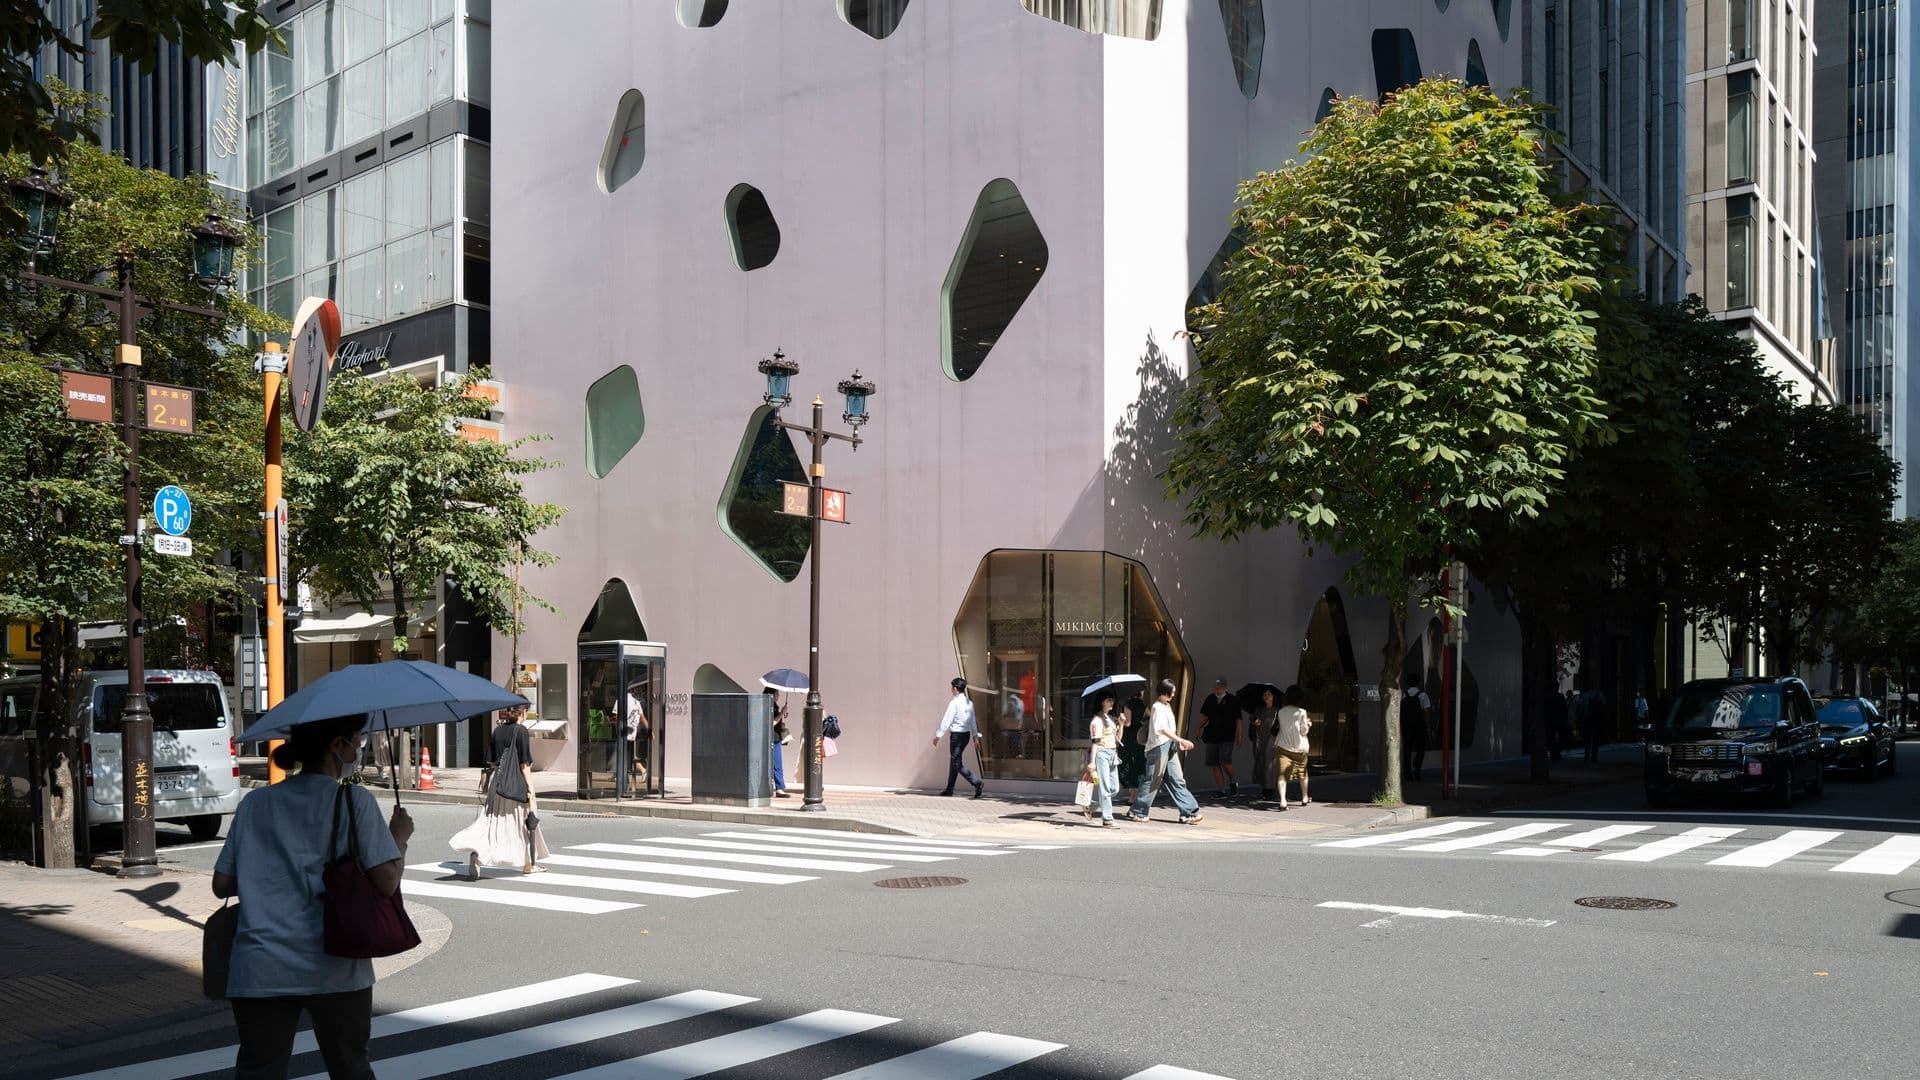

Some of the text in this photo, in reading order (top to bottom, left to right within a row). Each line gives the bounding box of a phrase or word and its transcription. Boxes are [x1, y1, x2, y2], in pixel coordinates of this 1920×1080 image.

[213, 61, 241, 158] Chopard
[337, 331, 393, 370] Chopard
[163, 498, 178, 529] P
[1056, 622, 1123, 632] MIKIMOTO
[134, 762, 149, 818] 並木通り
